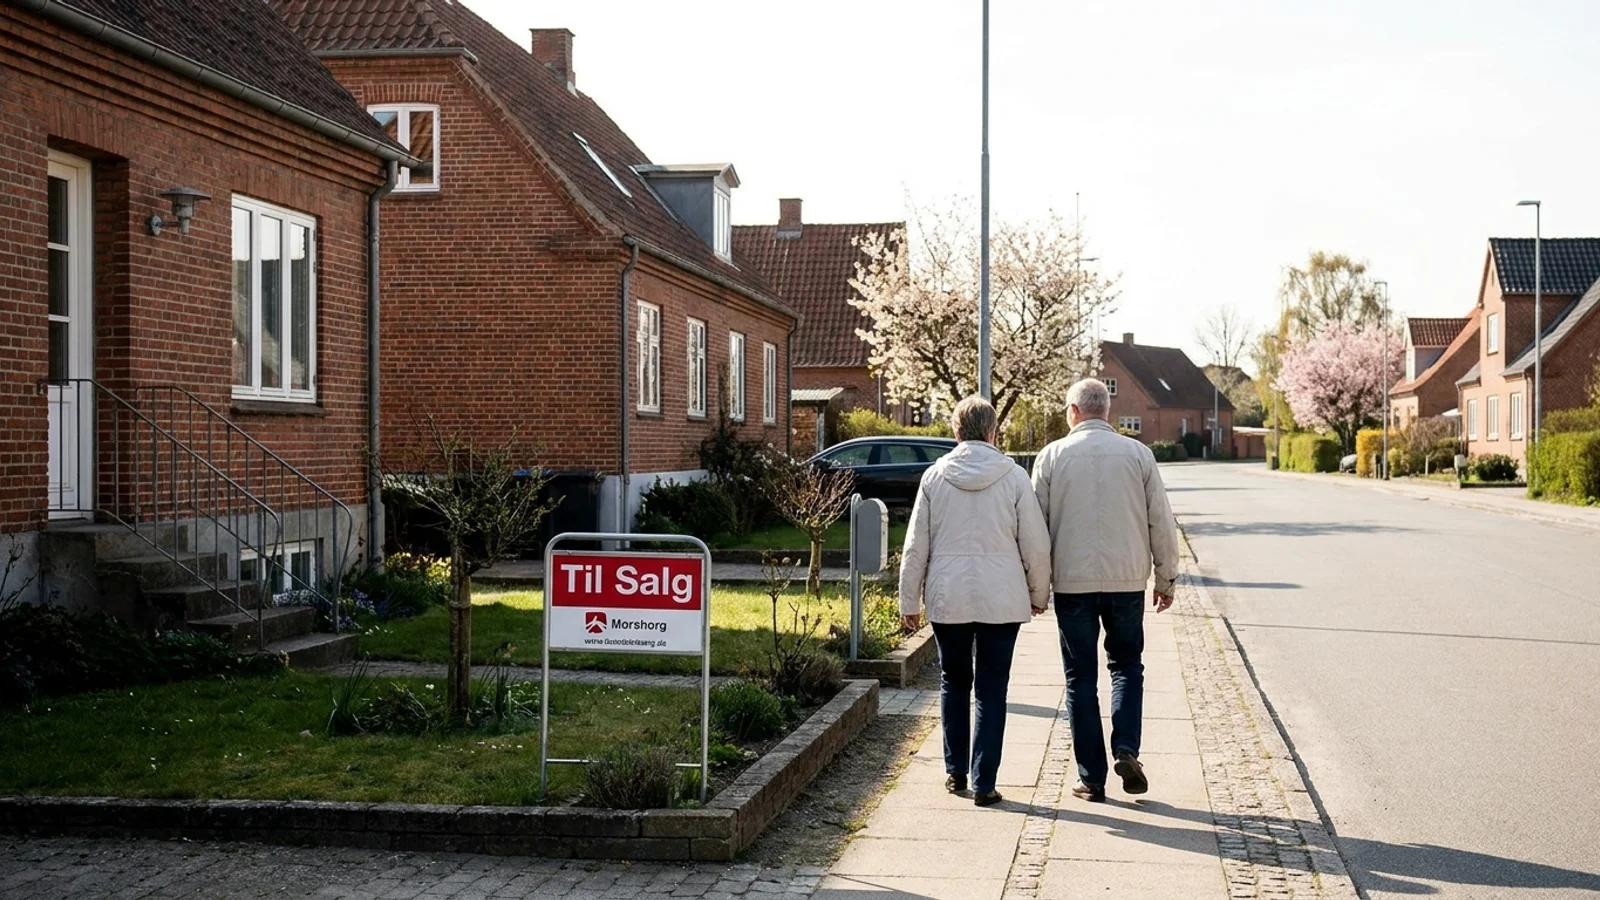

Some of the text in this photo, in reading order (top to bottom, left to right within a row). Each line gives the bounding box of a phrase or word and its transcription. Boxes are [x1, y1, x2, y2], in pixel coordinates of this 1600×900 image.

[560, 563, 692, 603] Til Salg
[611, 618, 667, 632] Morshorg
